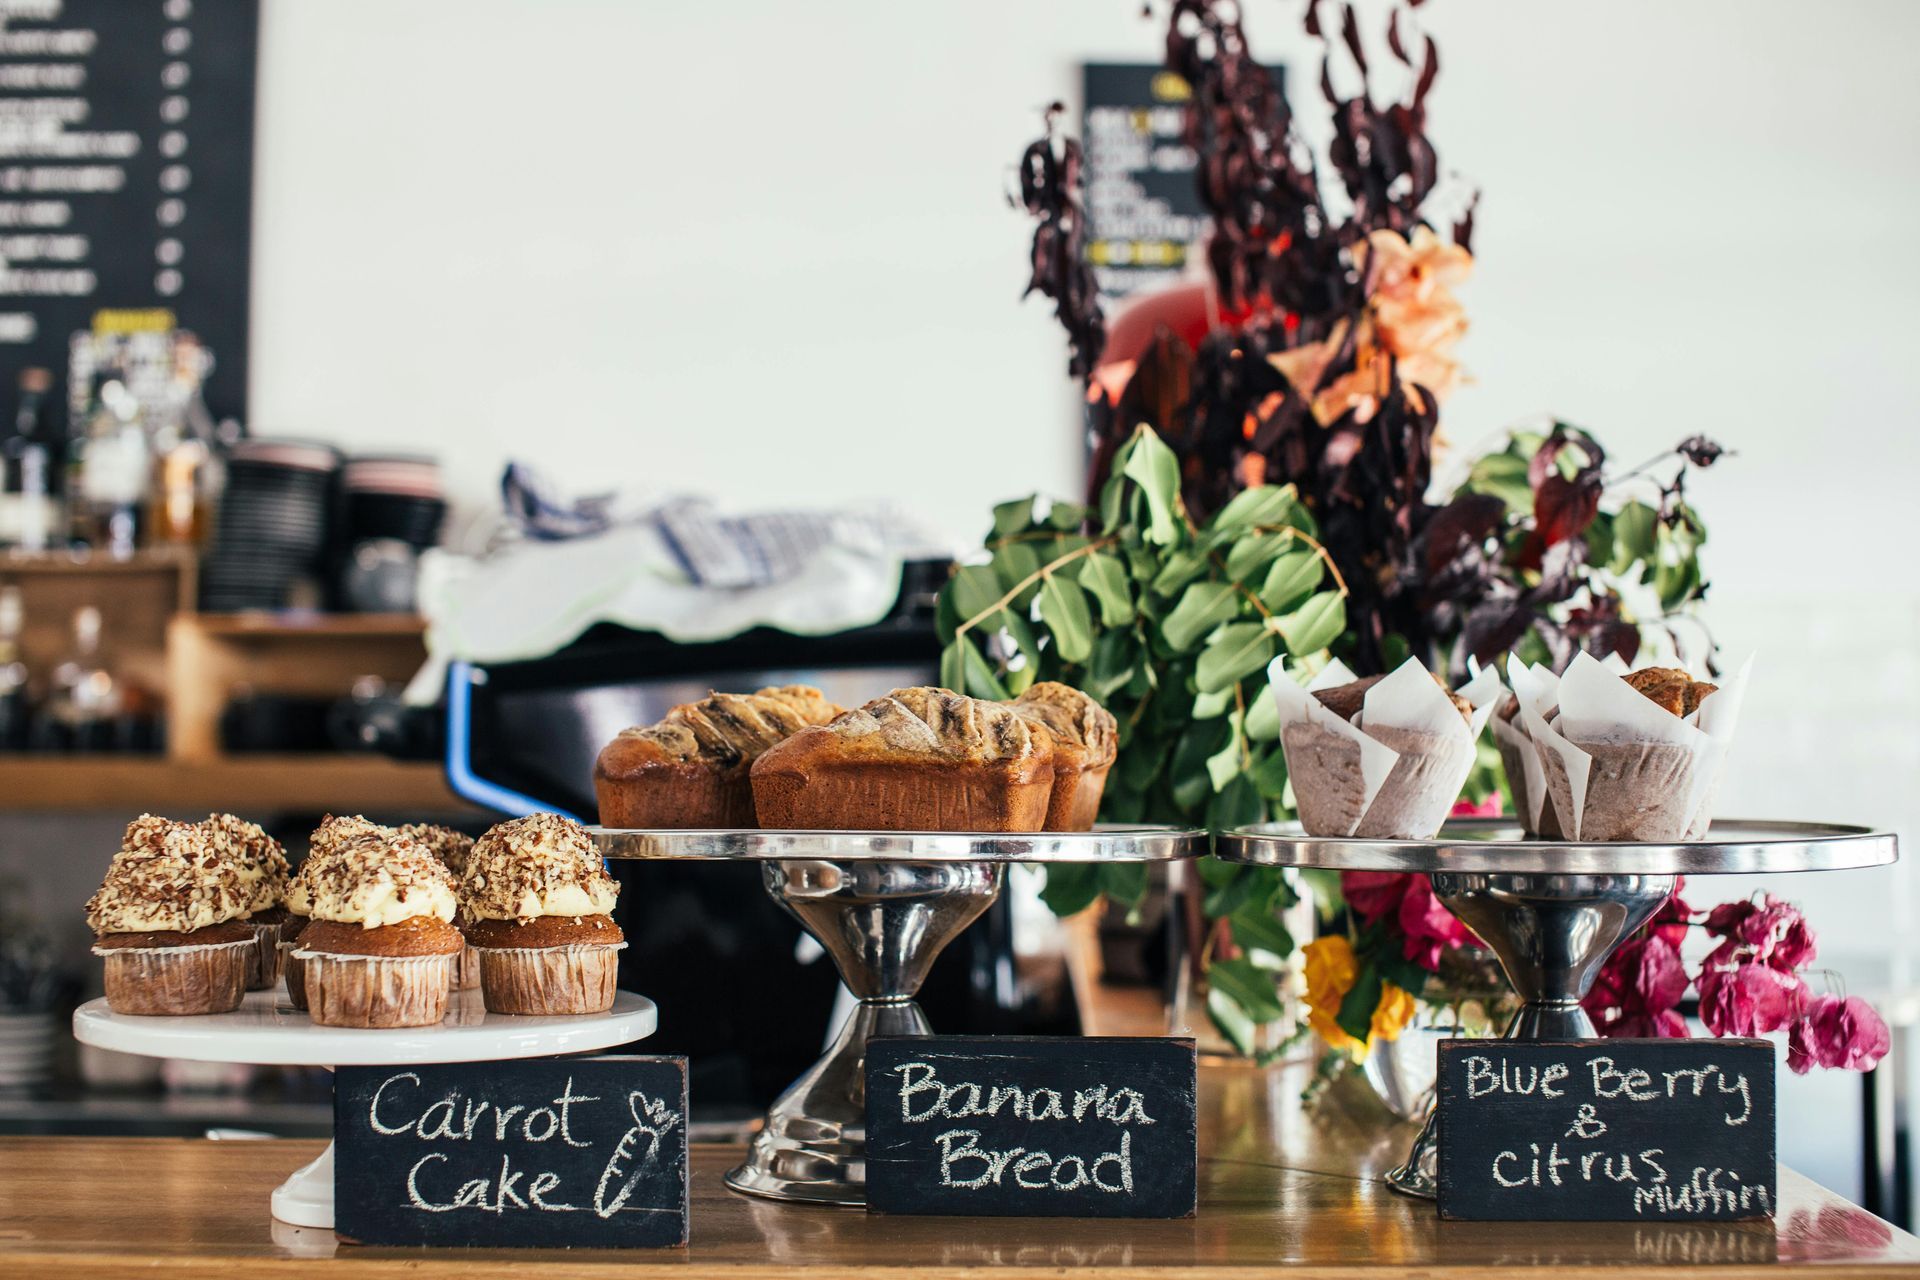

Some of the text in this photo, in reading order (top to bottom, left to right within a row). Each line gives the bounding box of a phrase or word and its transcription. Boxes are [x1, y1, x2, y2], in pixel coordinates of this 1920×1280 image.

[369, 1072, 601, 1148] Carrot
[894, 1062, 1156, 1126] Banana
[1461, 1055, 1752, 1126] Blue Berry
[1565, 1103, 1608, 1139] &
[406, 1153, 577, 1214] Cake
[936, 1129, 1135, 1196] Bread
[1633, 1166, 1772, 1215] Muffin
